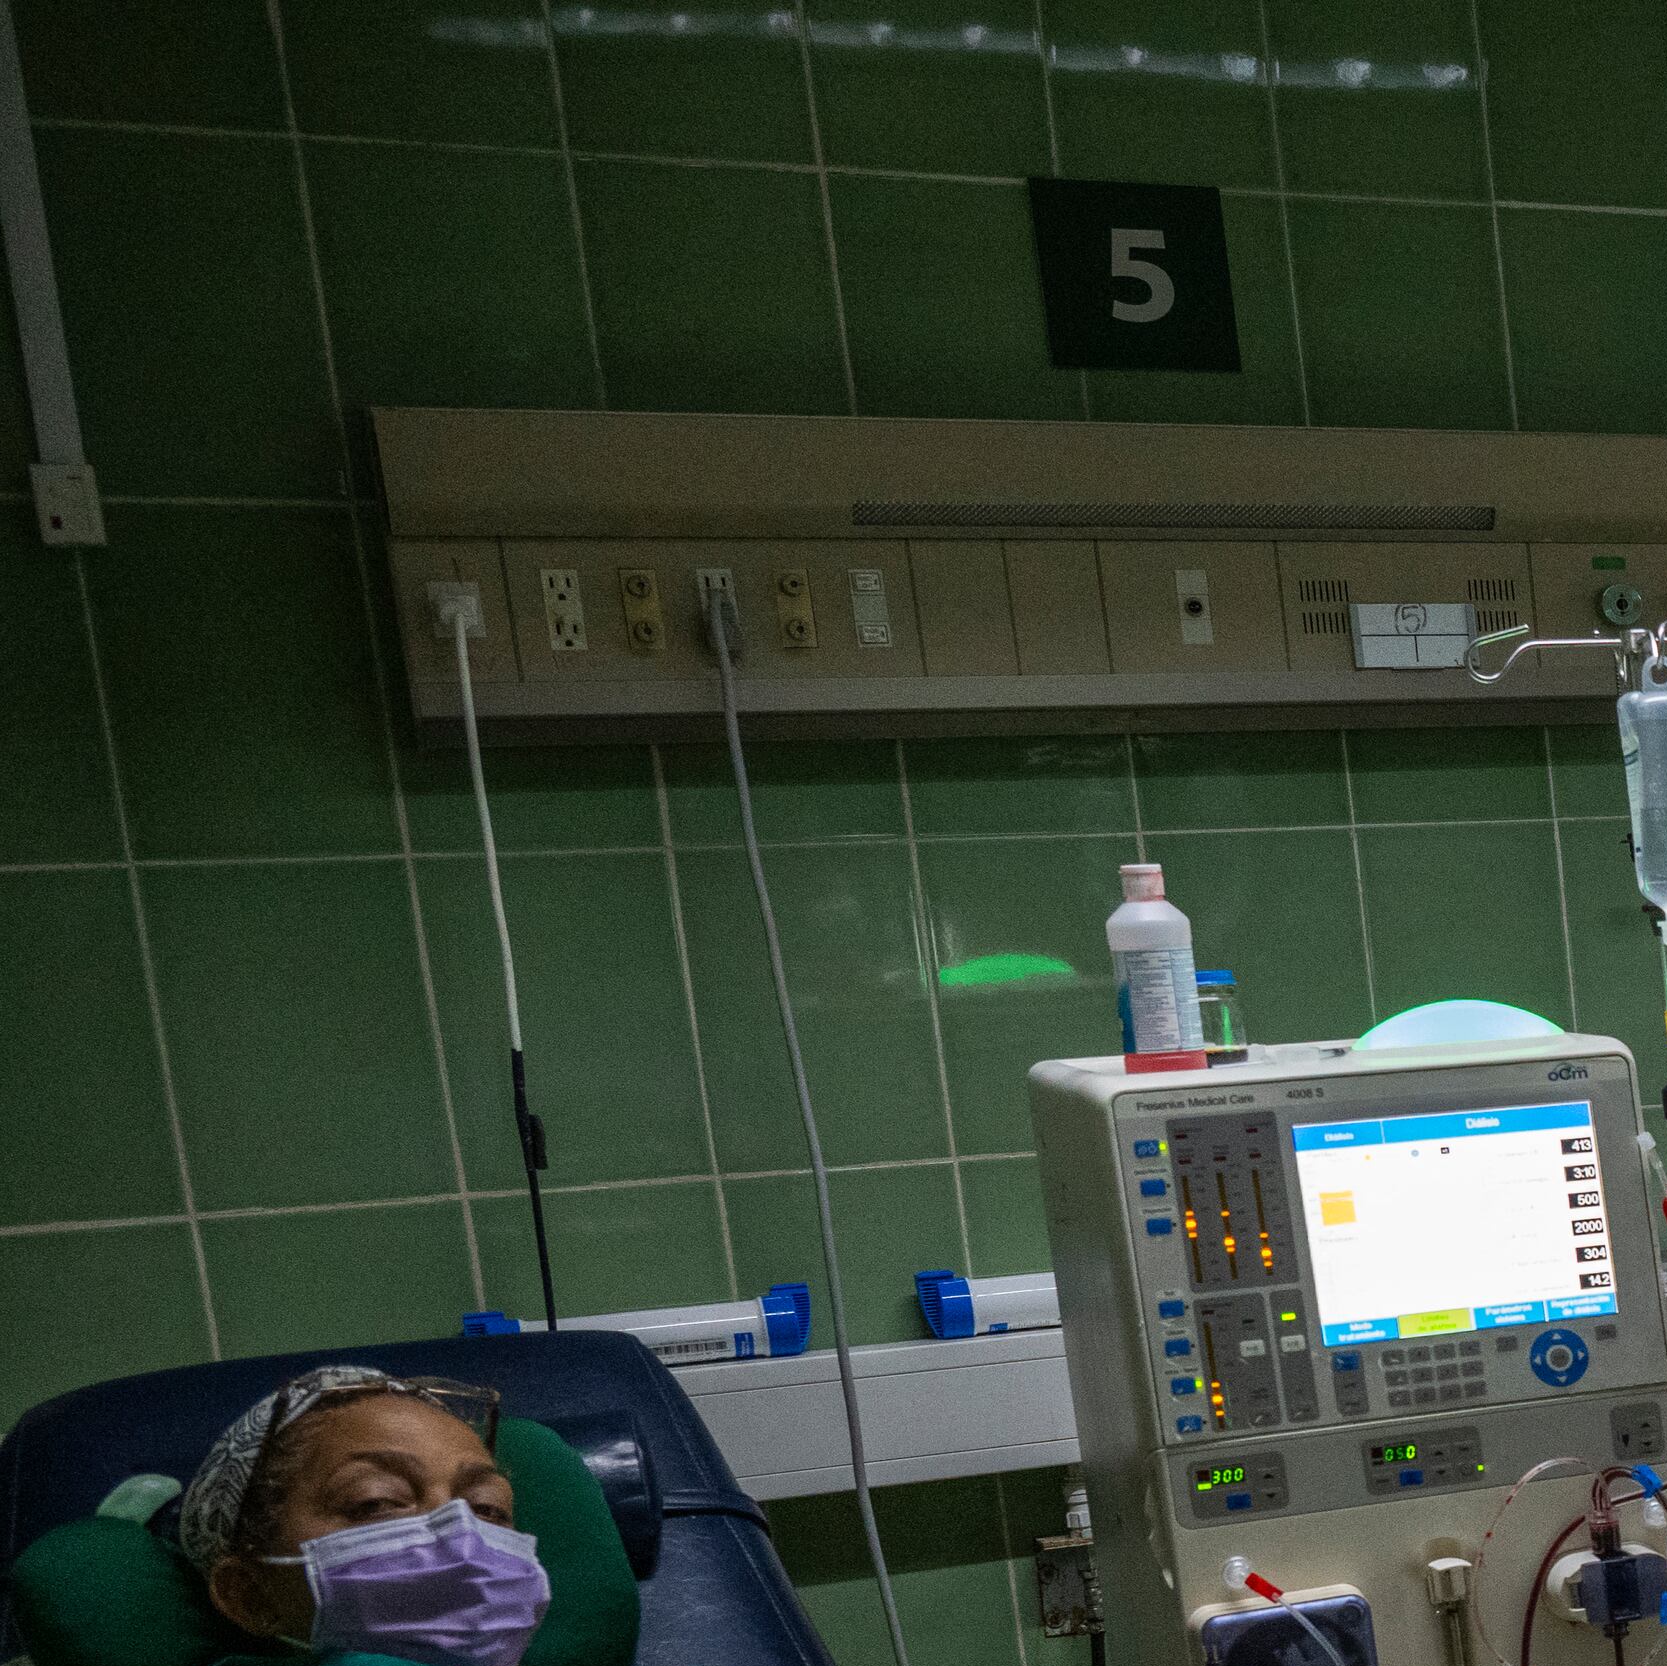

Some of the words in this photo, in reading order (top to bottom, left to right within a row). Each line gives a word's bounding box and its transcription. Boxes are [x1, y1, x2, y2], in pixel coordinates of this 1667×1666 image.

[1110, 228, 1175, 323] 5
[1285, 1088, 1314, 1099] 4008
[1315, 1087, 1324, 1098] S
[1136, 1099, 1186, 1112] Fresenius
[1187, 1095, 1227, 1109] Medical
[1228, 1094, 1255, 1105] Care
[1571, 1138, 1592, 1152] 413
[1573, 1165, 1596, 1179] 3:10
[1577, 1192, 1599, 1206] 500
[1573, 1219, 1603, 1233] 2000
[1584, 1246, 1606, 1260] 304
[1588, 1272, 1610, 1287] 14.2
[1211, 1467, 1245, 1486] 300
